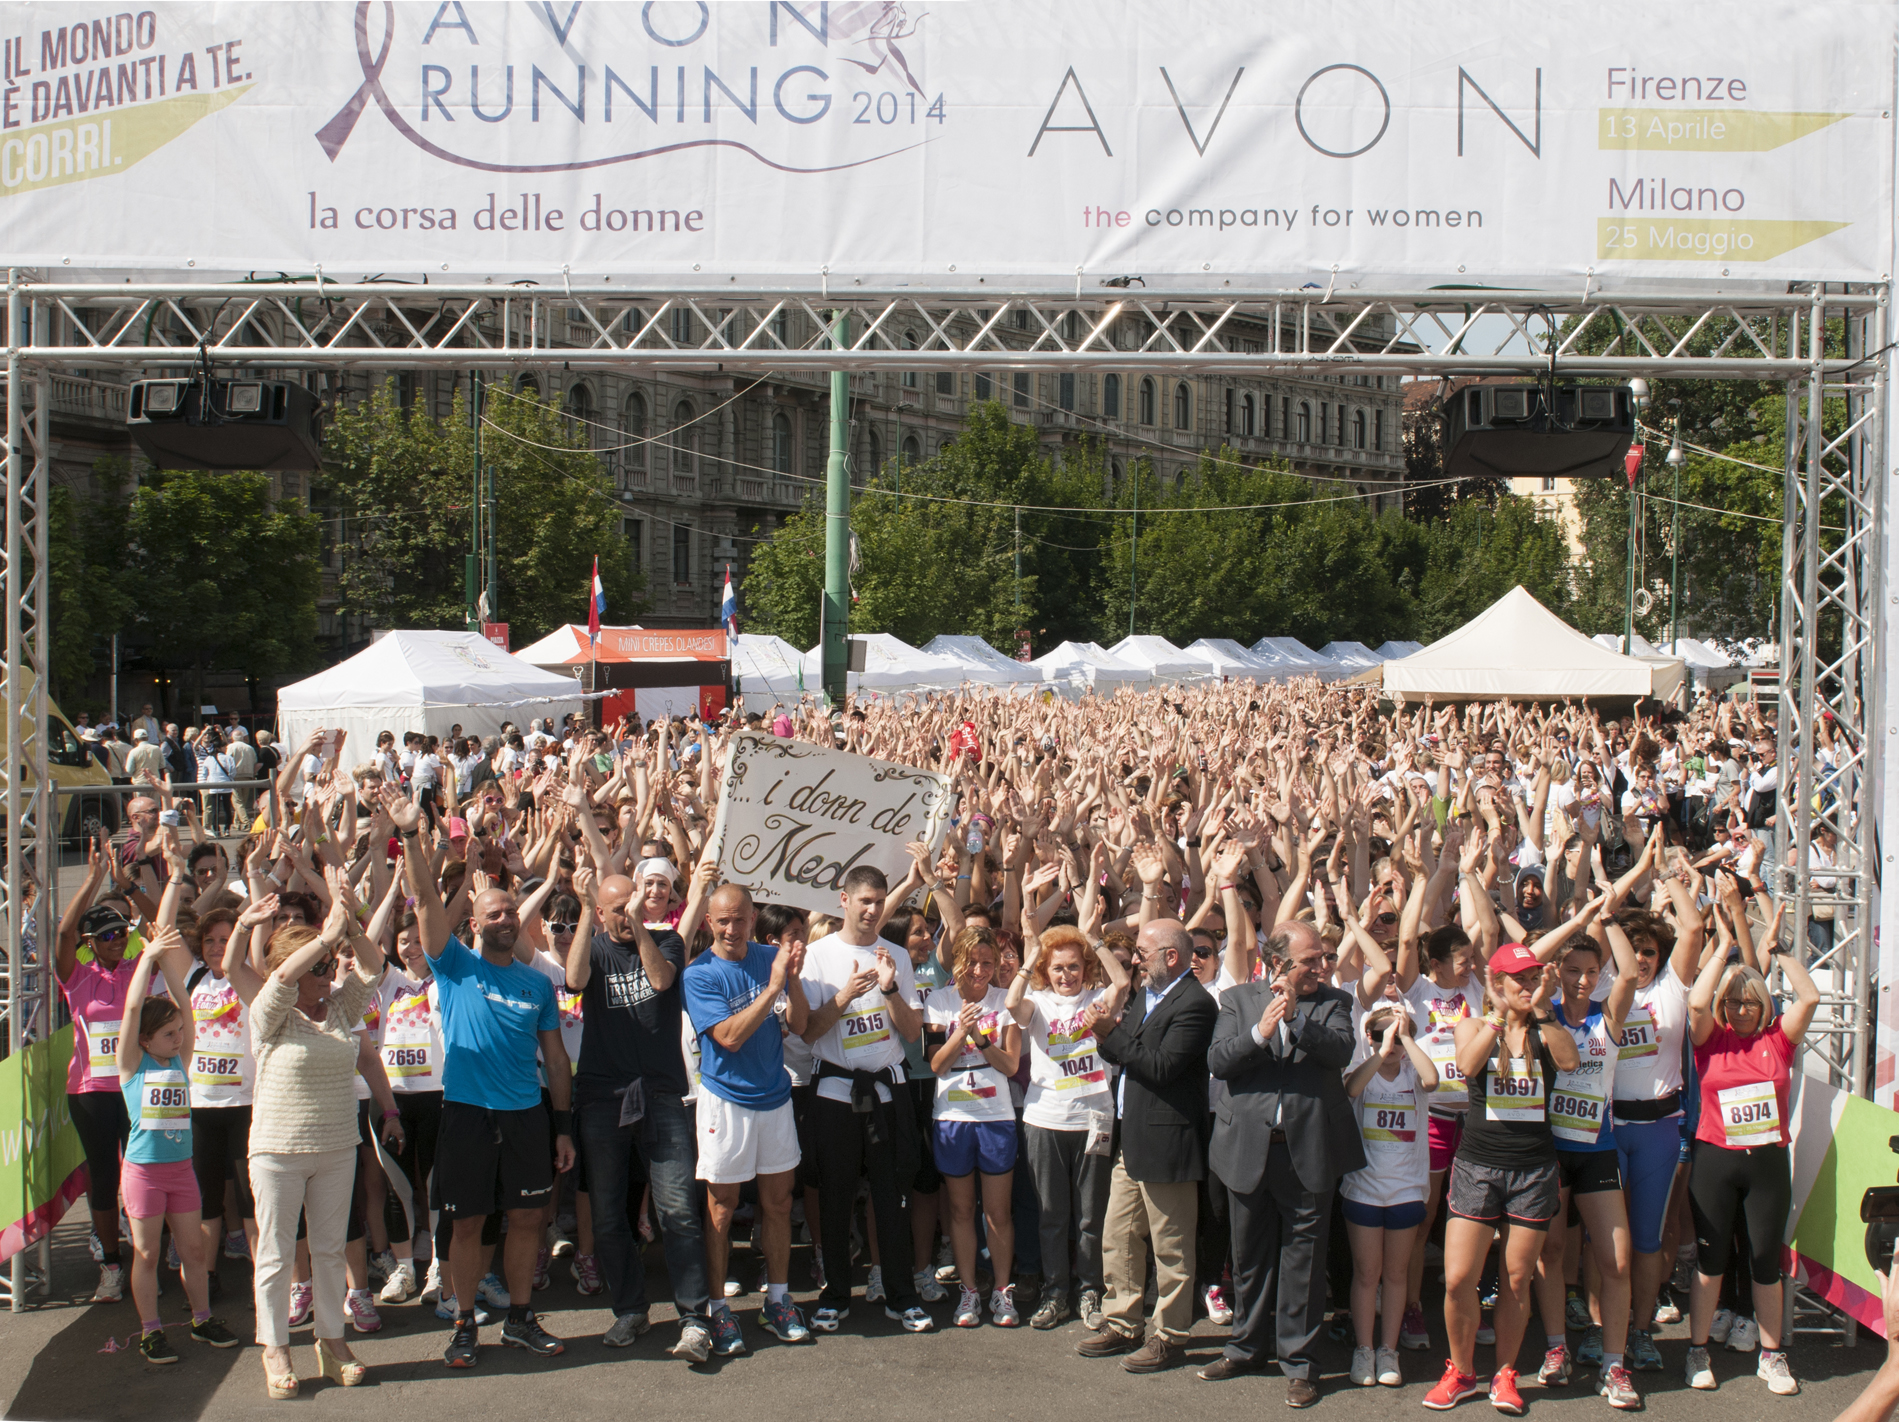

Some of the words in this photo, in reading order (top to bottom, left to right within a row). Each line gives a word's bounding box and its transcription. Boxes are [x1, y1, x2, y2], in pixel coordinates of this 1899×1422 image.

[422, 0, 829, 46] AVON
[5, 37, 30, 79] IL
[41, 10, 157, 71] MONDO
[3, 79, 20, 129] È
[31, 55, 166, 122] DAVANTI
[176, 52, 198, 92] A
[206, 39, 252, 88] TE.
[421, 64, 832, 124] RUNNING
[852, 91, 946, 125] 2014
[1607, 67, 1747, 101] Firenze
[1027, 63, 1542, 160] AVON
[1607, 116, 1637, 138] 13
[1646, 116, 1726, 144] Aprile
[1, 119, 122, 188] CORRI.
[1608, 177, 1745, 211] Milano
[308, 191, 339, 230] la
[355, 201, 457, 230] corsa
[473, 192, 565, 232] delle
[579, 193, 704, 232] donne
[1083, 205, 1131, 228] the
[1145, 206, 1298, 231] company
[1311, 204, 1354, 228] for
[1367, 208, 1483, 229] women
[1605, 226, 1638, 249] 25
[1650, 226, 1754, 256] Maggio
[618, 636, 640, 652] MINI
[676, 637, 715, 651] OLANDESI
[757, 769, 790, 806] i
[870, 792, 917, 836] de
[846, 1013, 883, 1036] 2615
[1620, 1026, 1648, 1047] 851
[197, 1056, 239, 1075] 5582
[388, 1048, 427, 1066] 2659
[1060, 1054, 1094, 1076] 1047
[967, 1072, 976, 1088] 4
[1493, 1077, 1539, 1096] 5697
[149, 1087, 187, 1106] 8951
[1553, 1094, 1599, 1119] 8964
[1376, 1109, 1406, 1129] 874
[1730, 1101, 1771, 1124] 8974
